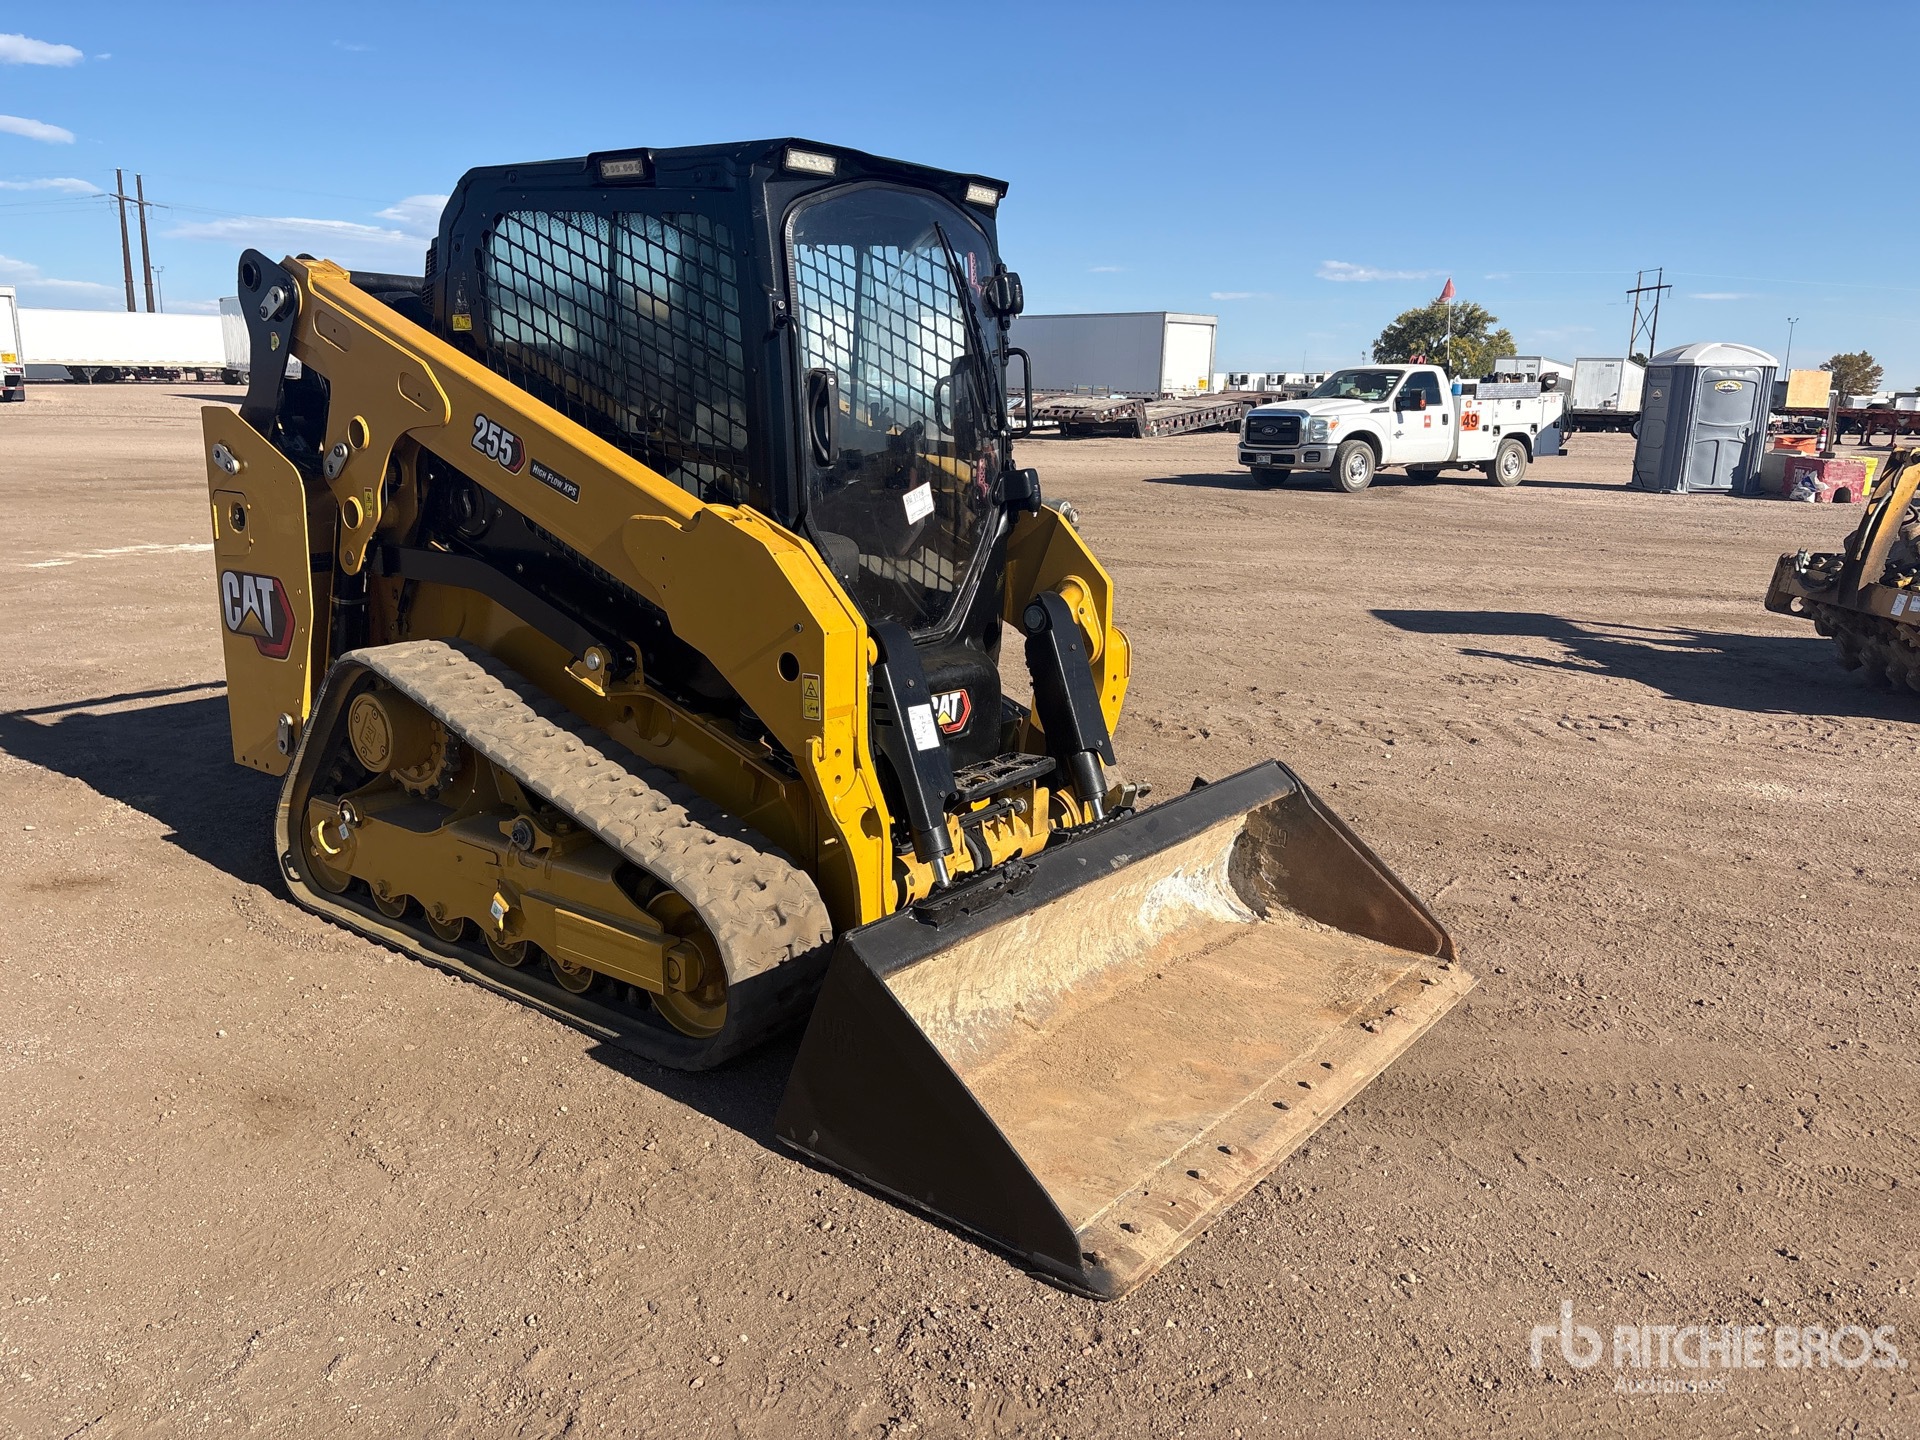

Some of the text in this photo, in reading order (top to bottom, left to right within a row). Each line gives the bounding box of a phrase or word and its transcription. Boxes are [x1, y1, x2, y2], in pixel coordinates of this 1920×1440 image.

[1462, 413, 1478, 428] 49
[472, 415, 514, 466] 255
[563, 482, 577, 497] XPS
[222, 571, 274, 638] CAT
